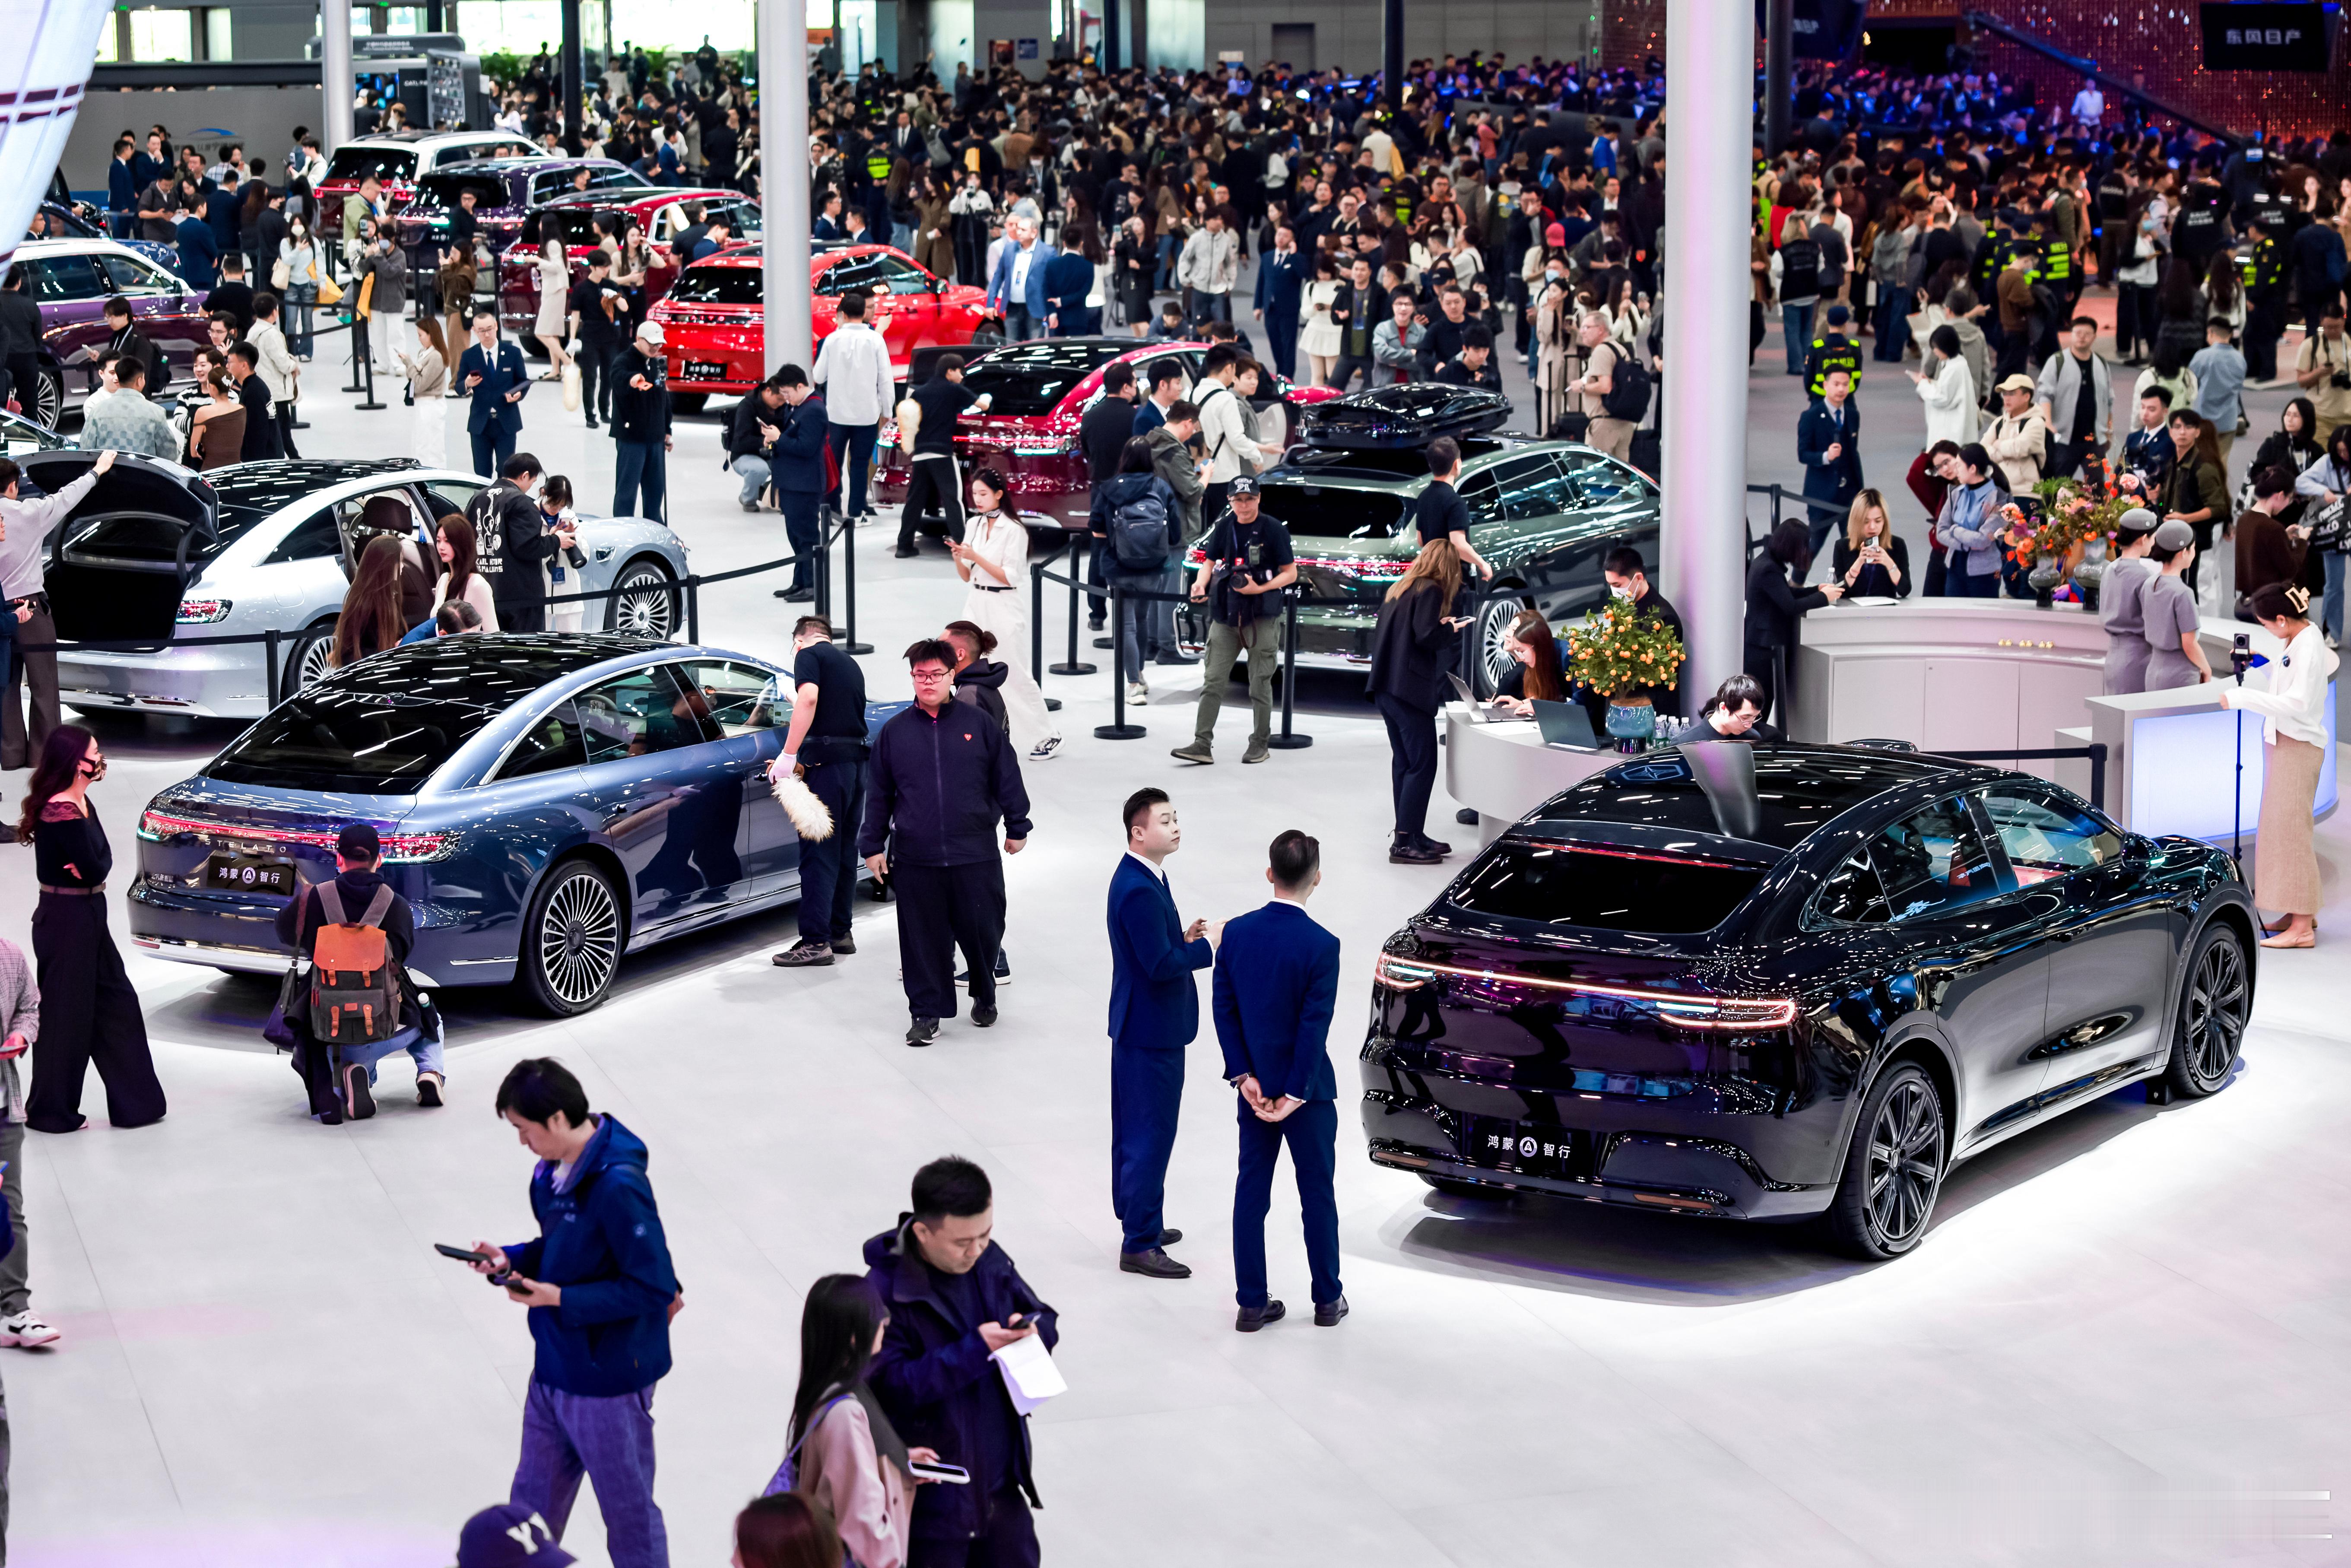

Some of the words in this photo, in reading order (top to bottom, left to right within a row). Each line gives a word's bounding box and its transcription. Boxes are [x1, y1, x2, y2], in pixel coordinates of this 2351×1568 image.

[2226, 29, 2301, 44] 东风日产
[556, 571, 563, 580] G
[205, 838, 286, 853] STELATO
[219, 867, 238, 879] 鸿蒙
[260, 871, 280, 884] 智行
[546, 991, 568, 1012] MICHELIN
[1488, 1135, 1514, 1151] 鸿蒙
[1543, 1143, 1571, 1159] 智行
[1868, 1222, 1882, 1247] PIRELLI
